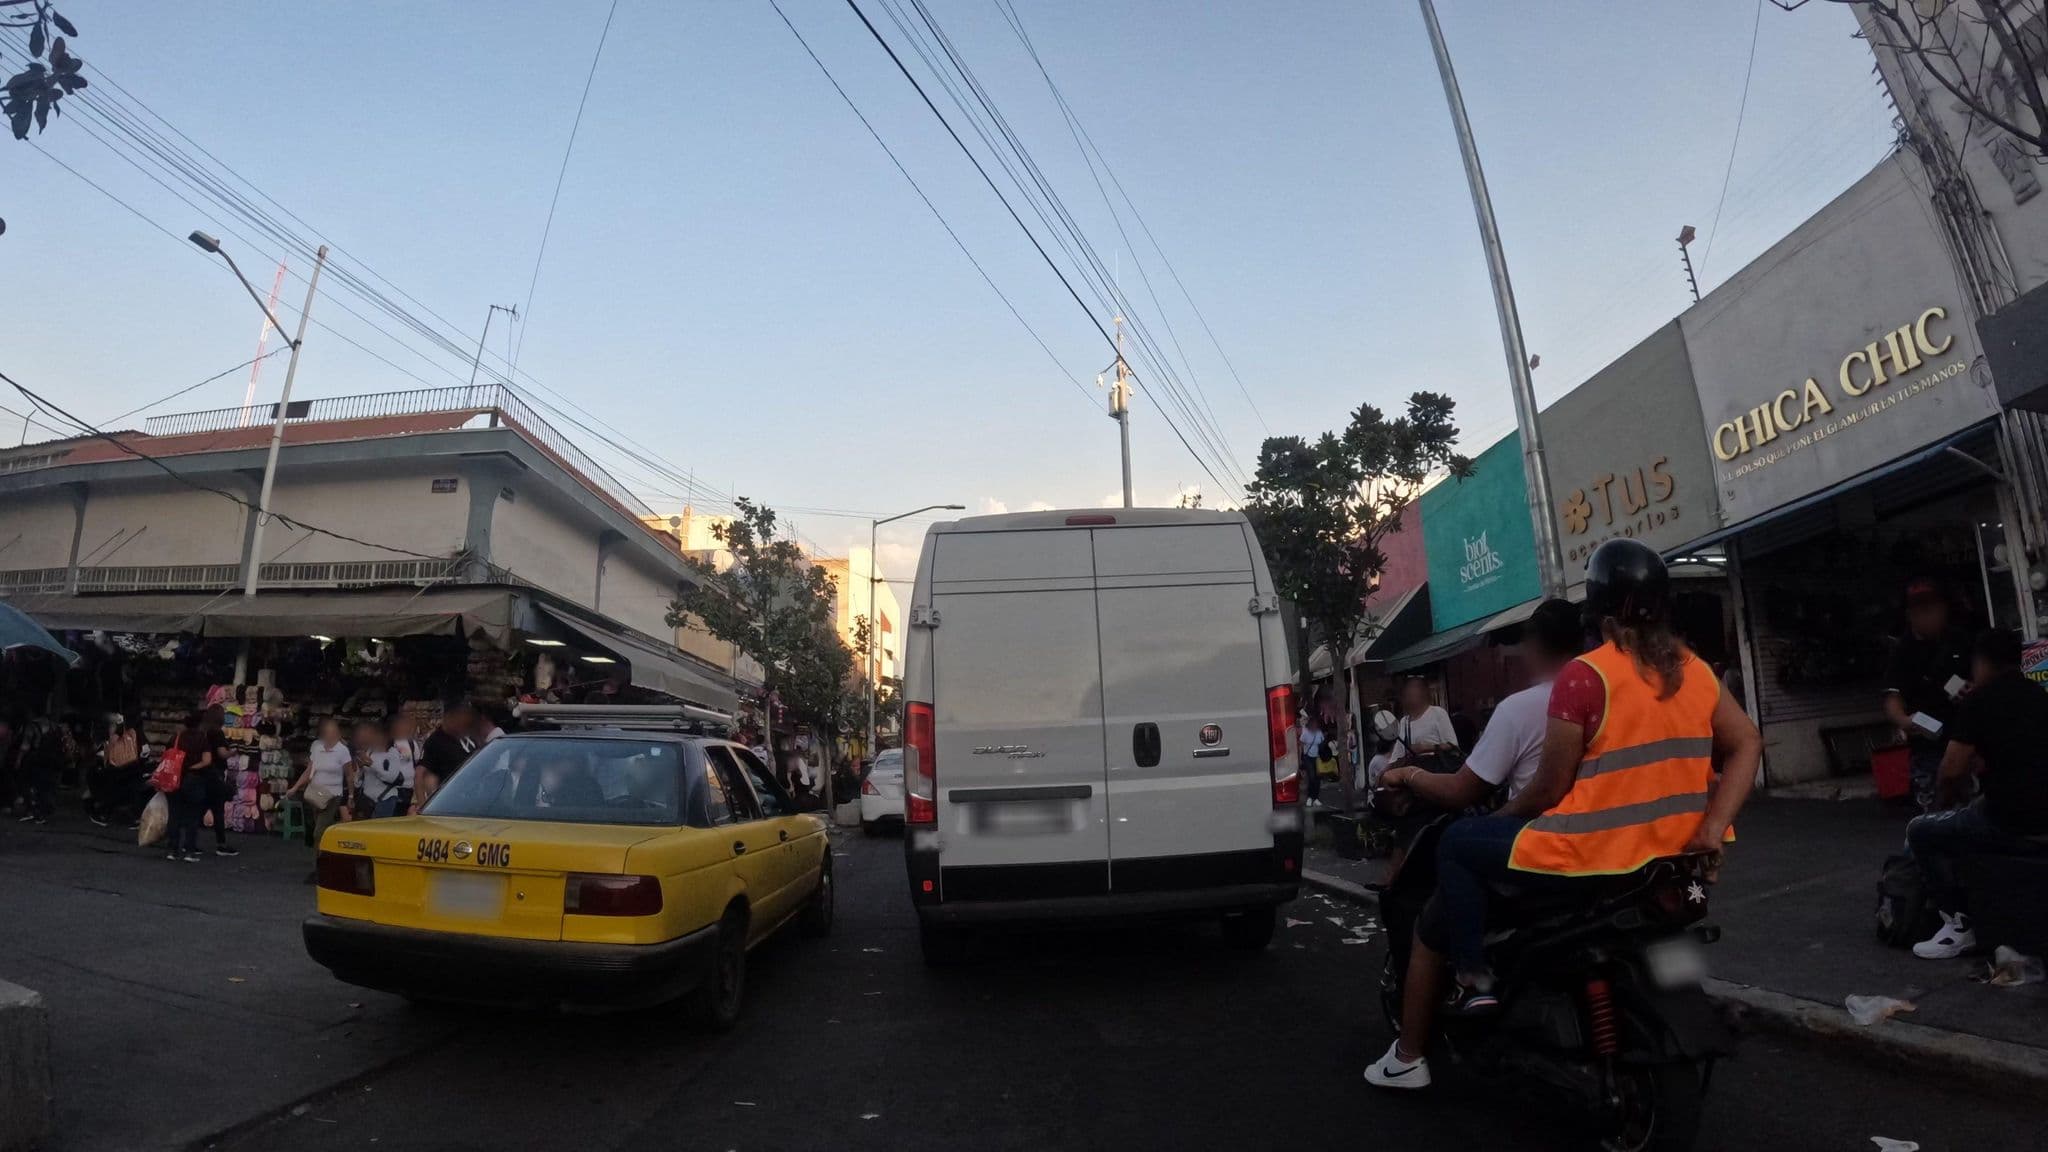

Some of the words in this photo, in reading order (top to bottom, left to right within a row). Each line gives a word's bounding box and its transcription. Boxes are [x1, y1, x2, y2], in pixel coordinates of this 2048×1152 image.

[1713, 377, 1833, 461] CHICA
[1839, 306, 1953, 397] CHIC
[1735, 456, 1766, 478] BOLSO
[1826, 403, 1880, 435] GLAMOUR
[1897, 381, 1920, 402] TUS
[1919, 360, 1967, 391] MANOS
[416, 838, 450, 864] 9484
[476, 842, 511, 868] GMG
